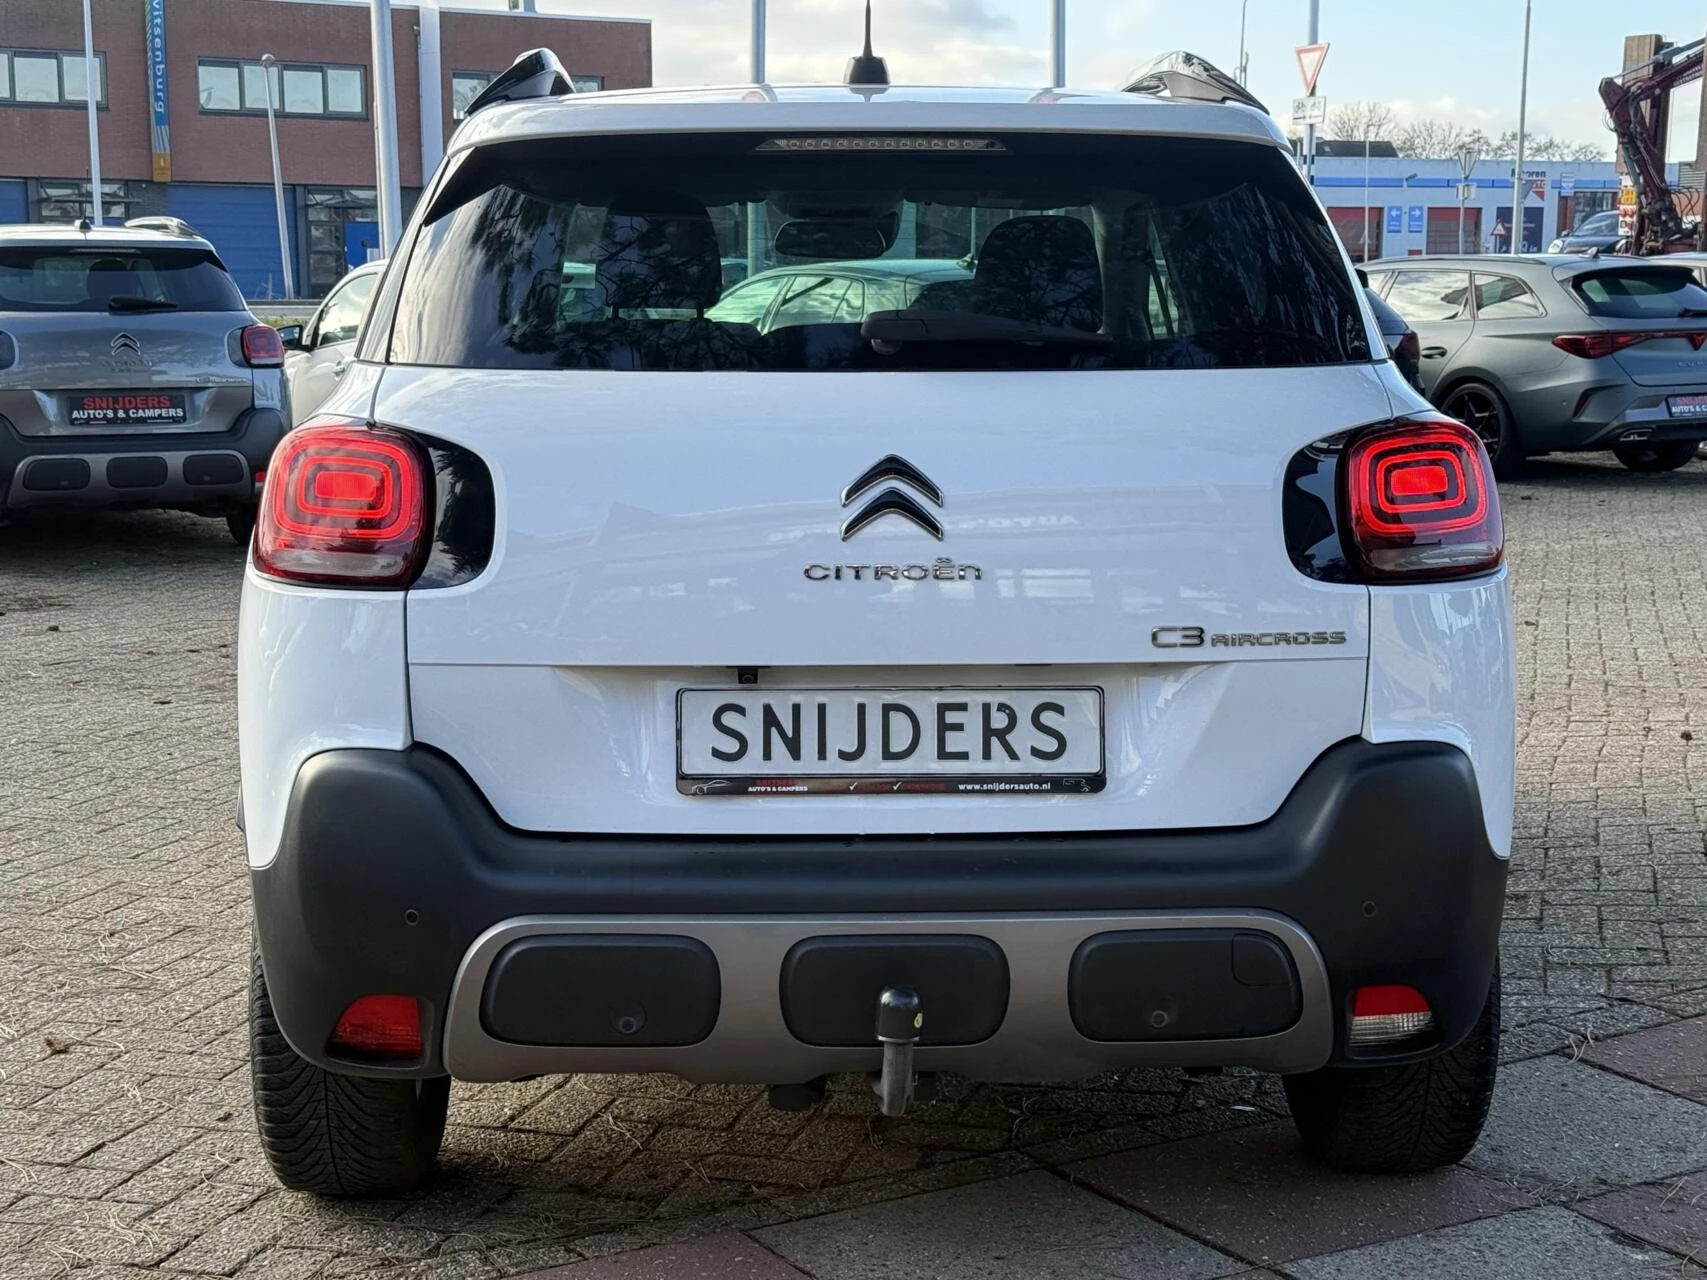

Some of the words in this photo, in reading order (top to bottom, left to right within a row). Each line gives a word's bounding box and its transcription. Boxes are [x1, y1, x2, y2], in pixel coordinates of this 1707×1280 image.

[83, 396, 171, 409] SNIJDERS
[71, 409, 114, 419] AUTO'S
[117, 409, 126, 418] &
[129, 408, 184, 418] CAMPERS
[1151, 626, 1205, 648] C3
[1211, 631, 1347, 647] AIRCROSS
[711, 702, 1067, 762] SNIJDERS
[958, 782, 1051, 792] www.snijdersauto.nl
